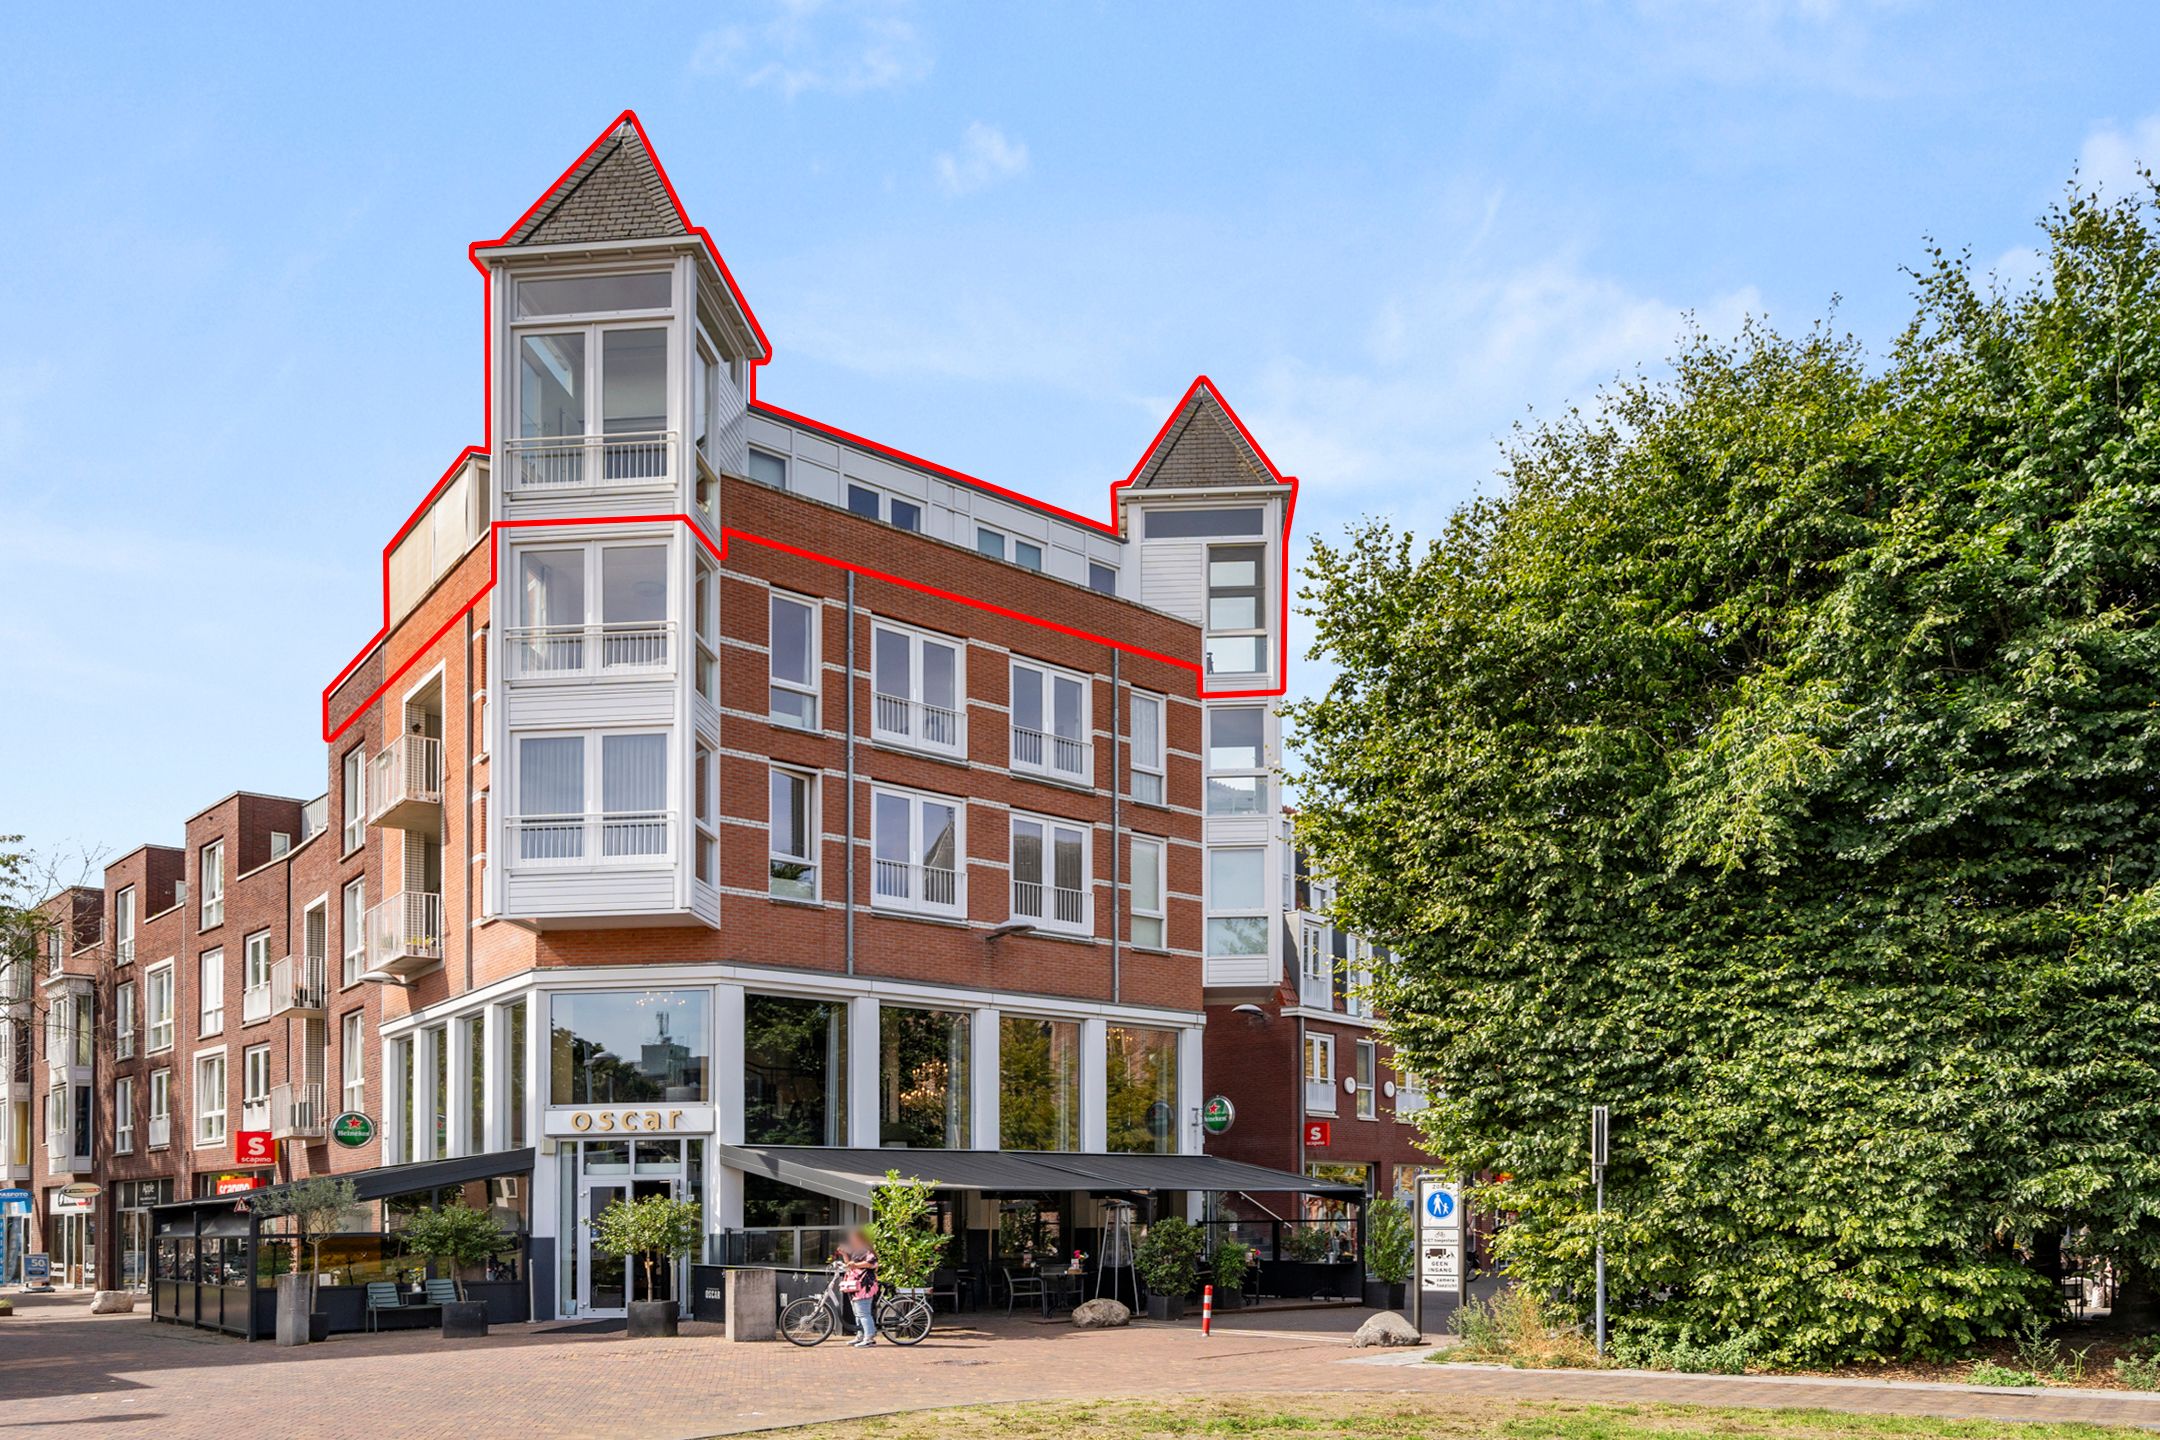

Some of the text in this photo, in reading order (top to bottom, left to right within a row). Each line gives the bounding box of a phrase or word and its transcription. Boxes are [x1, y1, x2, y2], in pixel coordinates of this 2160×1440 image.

[571, 1110, 682, 1132] oscar
[1310, 1127, 1322, 1140] S
[248, 1137, 266, 1156] S
